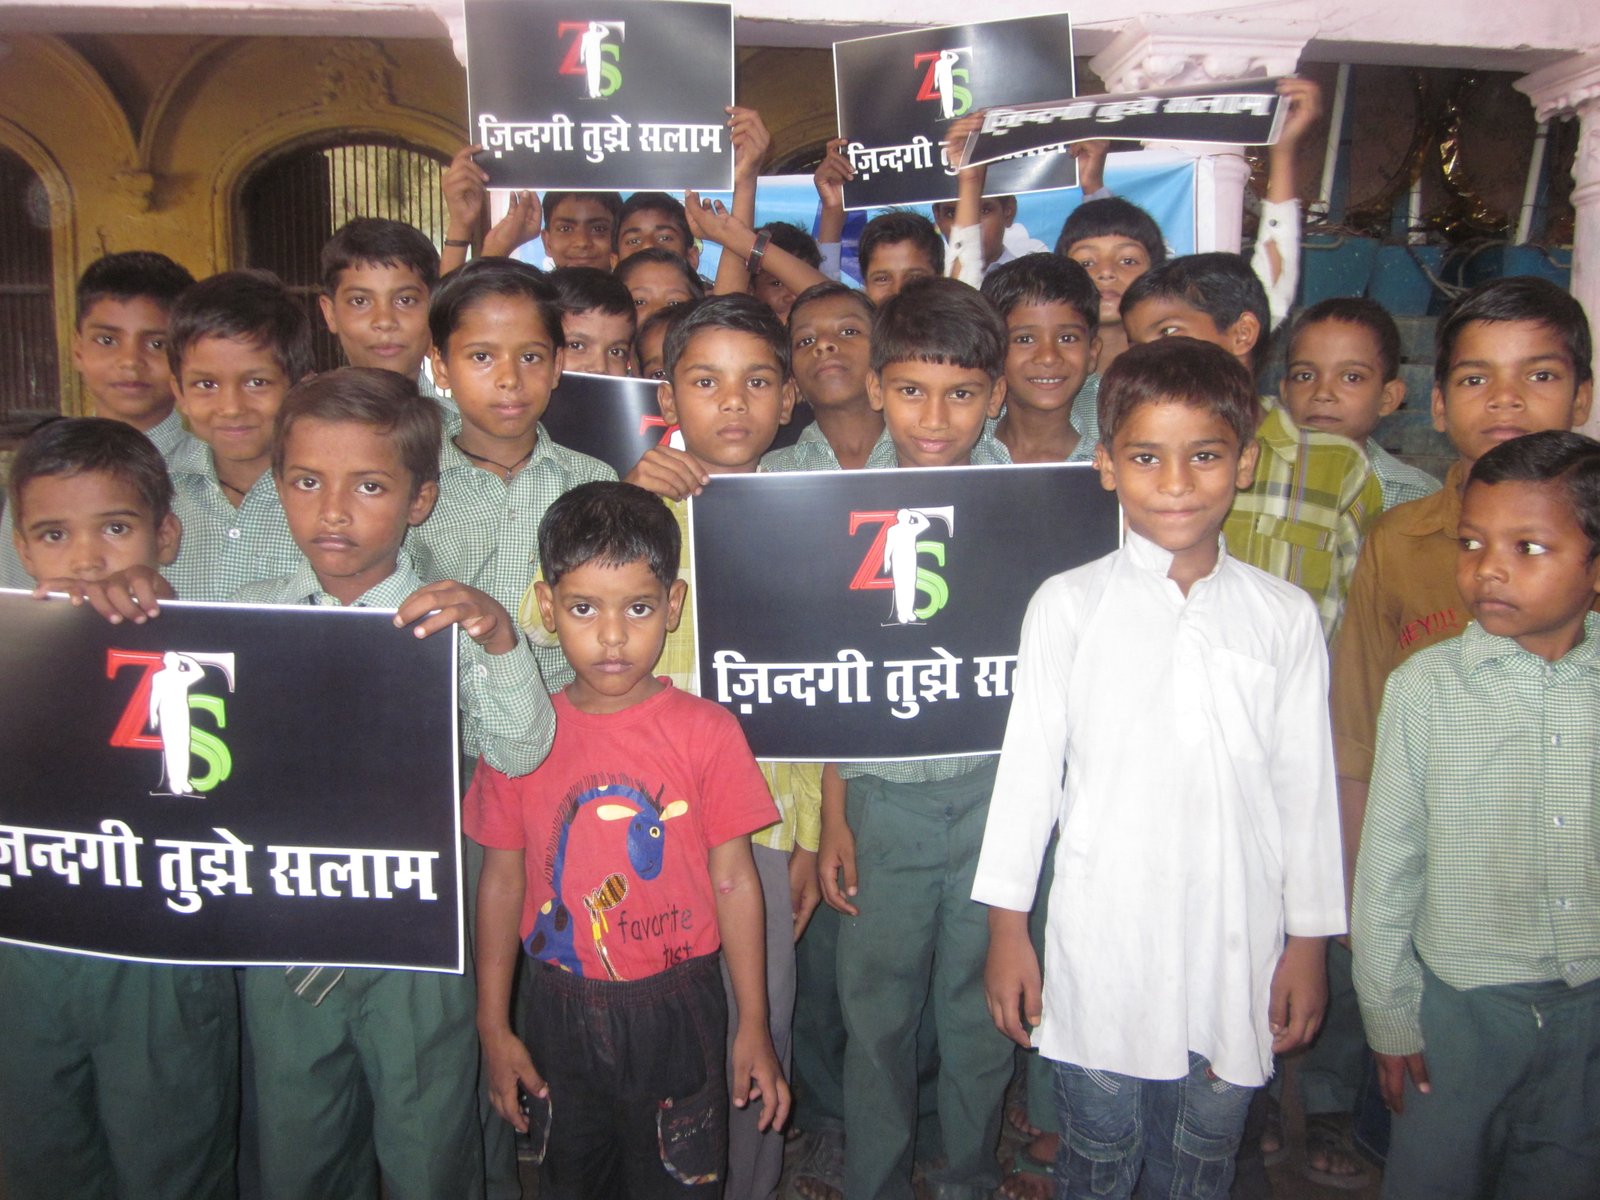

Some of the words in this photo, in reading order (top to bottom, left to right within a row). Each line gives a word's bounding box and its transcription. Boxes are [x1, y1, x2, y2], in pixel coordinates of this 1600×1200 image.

[479, 114, 575, 158] ज़िन्दगी
[581, 115, 630, 163] तुझे
[639, 124, 723, 153] सलाम
[712, 649, 873, 714] ज़िन्दगी
[883, 647, 963, 719] तुझे
[155, 828, 253, 913] तुझे
[267, 845, 439, 900] सलाम
[618, 903, 693, 945] favorite
